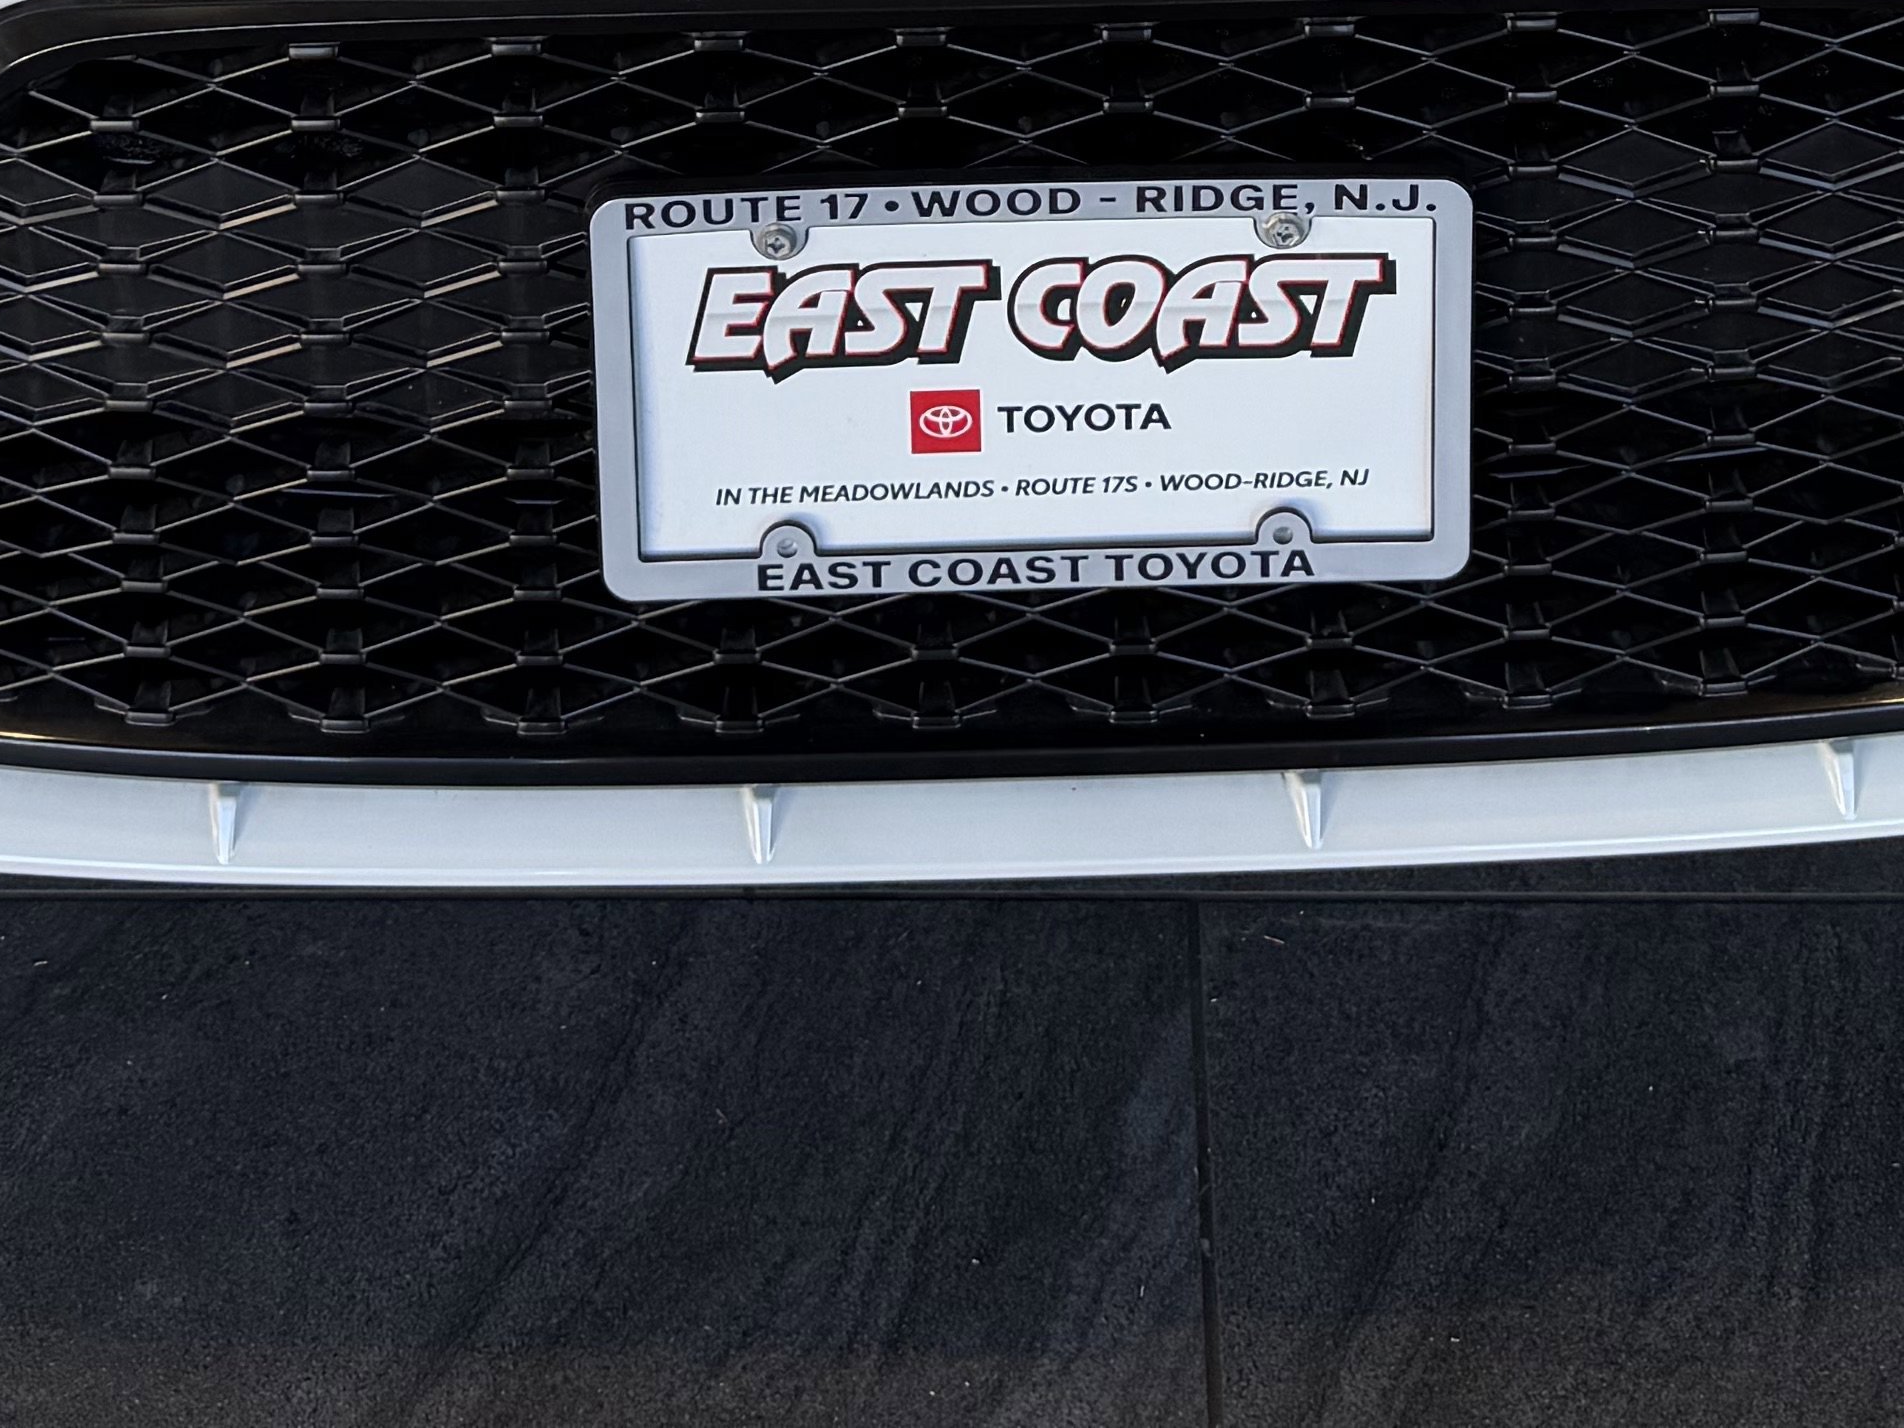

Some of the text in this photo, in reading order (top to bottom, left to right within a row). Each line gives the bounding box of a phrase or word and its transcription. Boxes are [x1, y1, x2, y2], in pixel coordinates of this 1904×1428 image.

[624, 195, 802, 231] ROUTE
[820, 193, 869, 221] 17
[911, 187, 1082, 218] WOOD
[1136, 184, 1315, 216] RIDGE,
[1334, 184, 1437, 212] N.J.
[686, 253, 1397, 384] EAST COAST
[997, 403, 1172, 433] TOYOTA
[716, 468, 1370, 506] IN THE MEADOWLANDS ROUTE 17S WOOD-RIDGE, NJ
[757, 549, 1315, 591] EAST COAST TOYOTA
